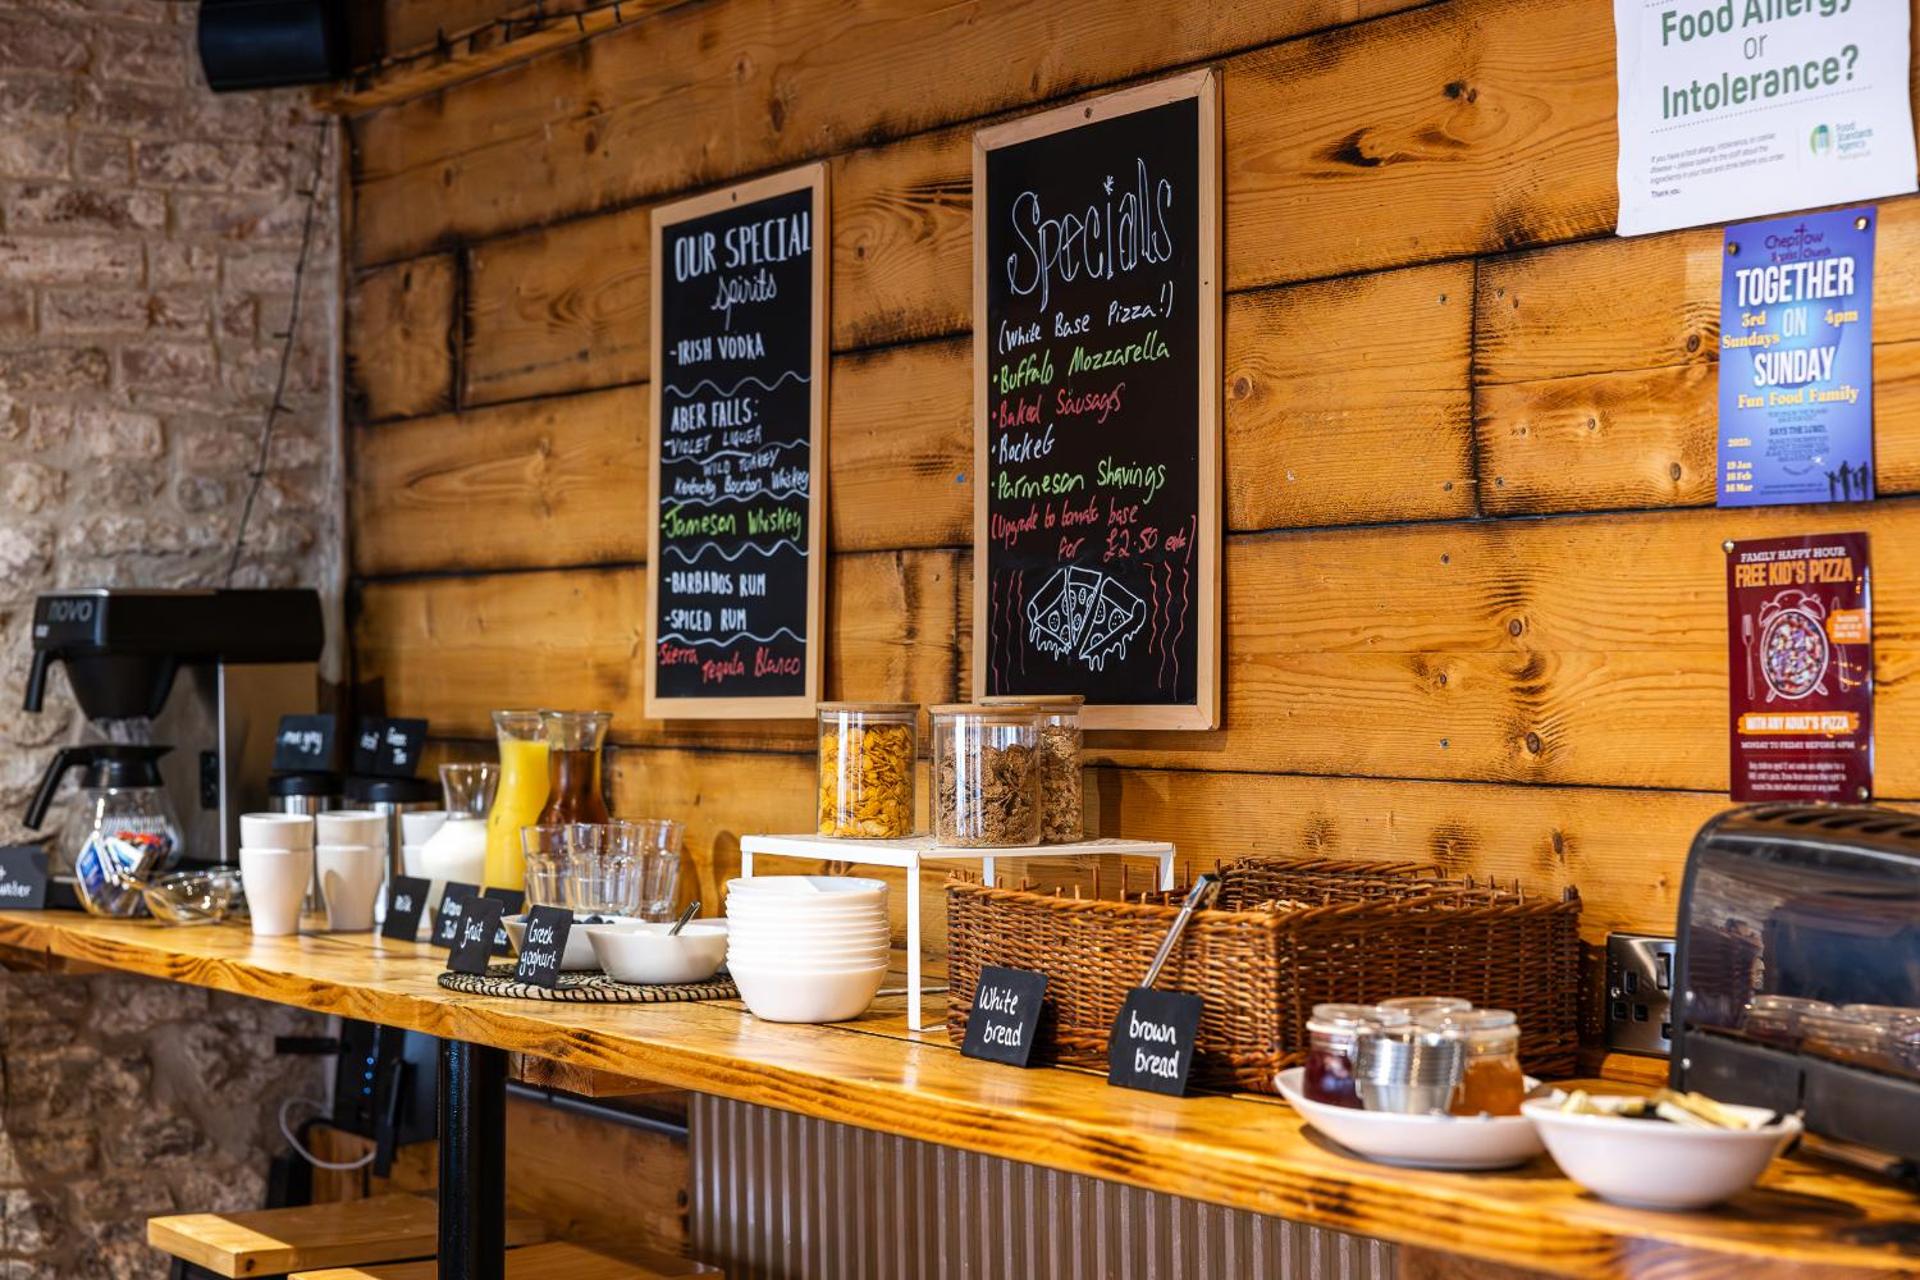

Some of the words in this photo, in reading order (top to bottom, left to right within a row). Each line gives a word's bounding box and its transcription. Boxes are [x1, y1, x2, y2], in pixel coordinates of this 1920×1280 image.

[1661, 0, 1734, 46] Food
[1744, 33, 1768, 60] or
[1662, 44, 1859, 120] Intolerance?
[674, 231, 717, 283] OUR
[725, 211, 811, 269] SPECIAL
[1735, 256, 1855, 307] TOGETHER
[711, 268, 777, 331] spirits
[1054, 312, 1090, 337] Base
[1108, 280, 1174, 326] Pizza!)
[1741, 311, 1767, 328] 3rd
[1783, 306, 1807, 337] ON
[1824, 309, 1858, 328] 4pm
[717, 332, 765, 360] VODKA
[1068, 330, 1171, 376] Mozzarella
[1722, 330, 1780, 349] Sundays
[1754, 347, 1836, 387] SUNDAY
[1738, 394, 1764, 409] Fun
[1769, 390, 1804, 406] Food
[1808, 385, 1859, 404] Family
[671, 403, 707, 433] ABER
[712, 398, 759, 428] FALLS:
[771, 466, 810, 491] Whiskey
[1097, 456, 1166, 505] Shavings
[748, 507, 801, 541] Whiskey
[1045, 503, 1056, 529] to
[1107, 496, 1139, 528] base
[1103, 527, 1158, 563] £2.50
[1741, 551, 1776, 563] FAMILY
[1778, 549, 1810, 560] HAPPY
[1813, 546, 1846, 558] HOUR
[739, 573, 766, 597] RUM
[1735, 563, 1767, 588] FREE
[1769, 561, 1806, 586] KID'S
[1808, 557, 1854, 583] PIZZA
[720, 608, 747, 632] RUM
[754, 646, 800, 677] Blanco
[460, 916, 484, 949] fruit
[528, 918, 553, 944] Greek
[518, 950, 557, 977] yoghurt
[979, 986, 1019, 1016] White
[983, 1020, 1023, 1047] bread
[1129, 1010, 1177, 1045] brown
[1134, 1048, 1179, 1079] bread
